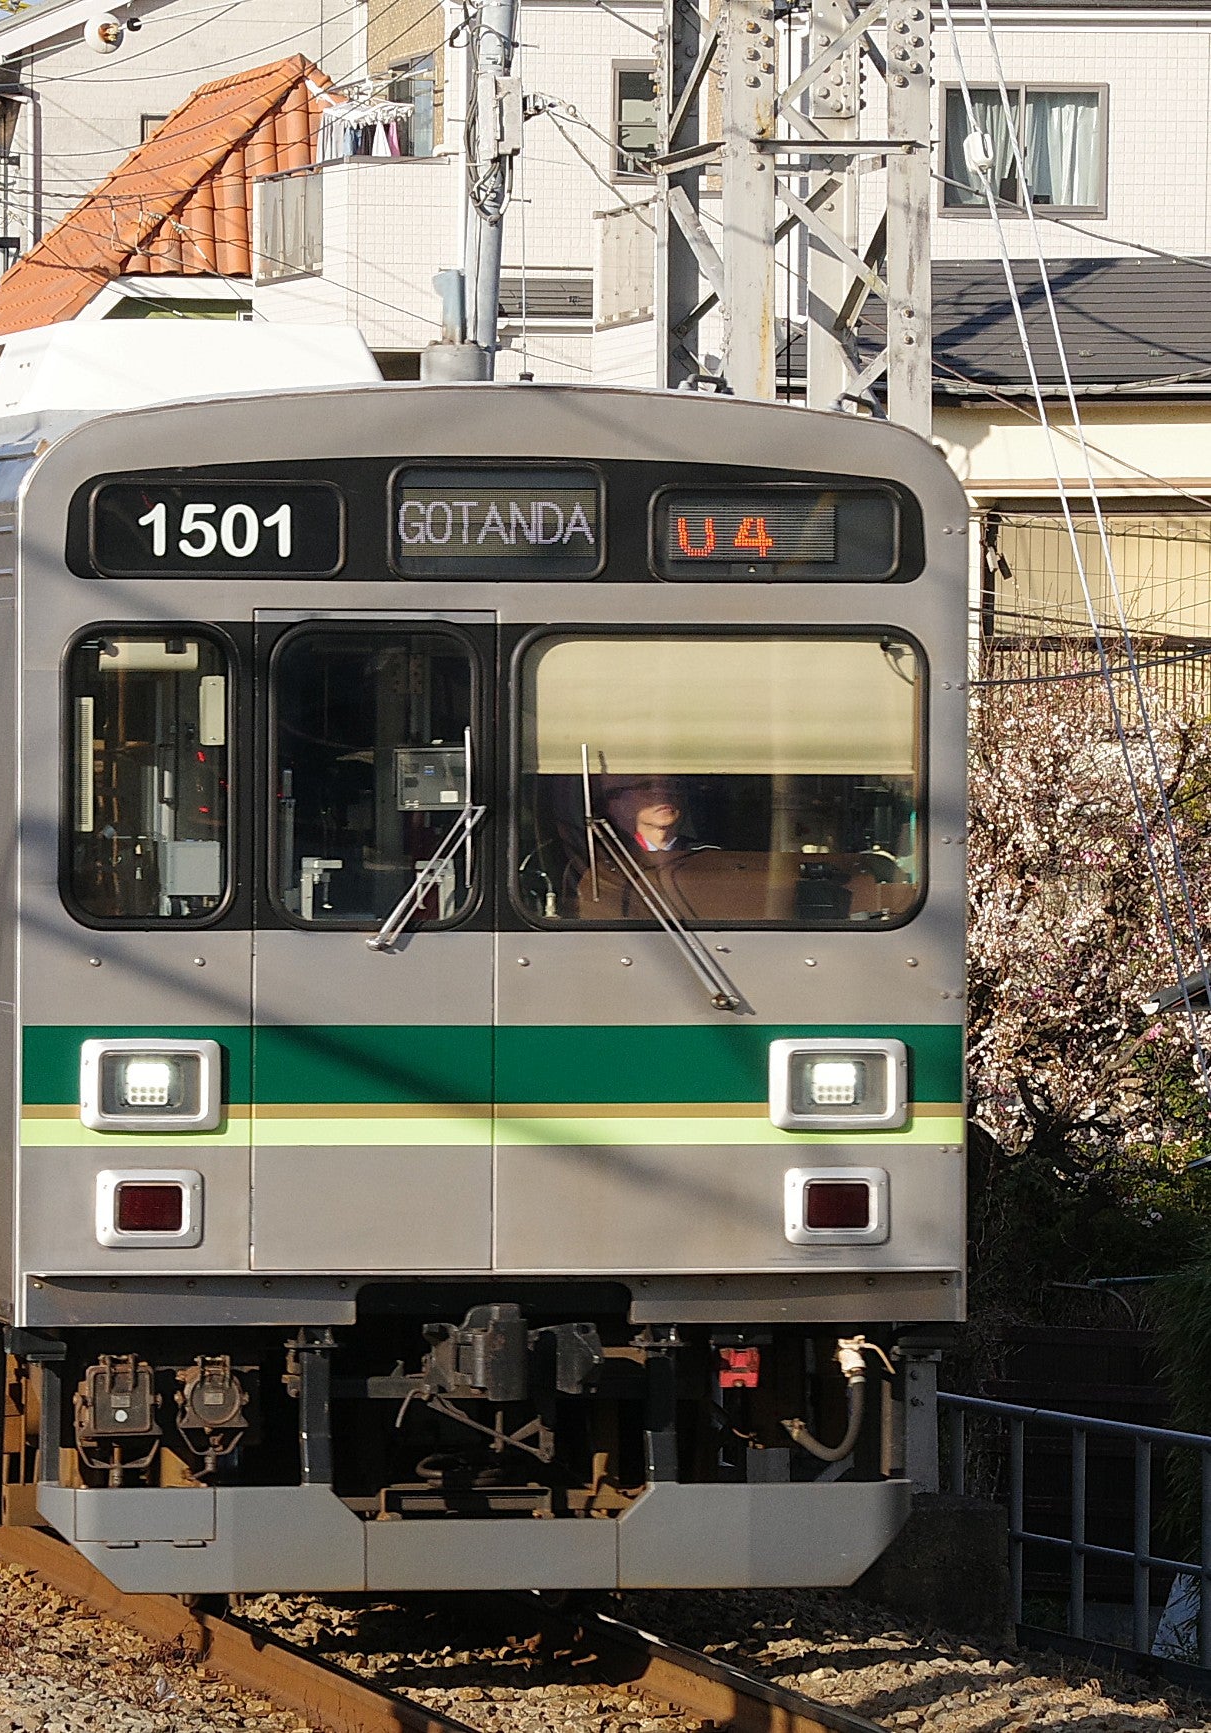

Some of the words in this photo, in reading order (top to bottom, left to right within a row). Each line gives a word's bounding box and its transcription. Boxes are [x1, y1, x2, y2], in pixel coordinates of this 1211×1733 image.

[138, 503, 291, 557] 1501
[399, 501, 595, 544] GOTANDA
[677, 517, 715, 557] U
[733, 517, 774, 557] 4
